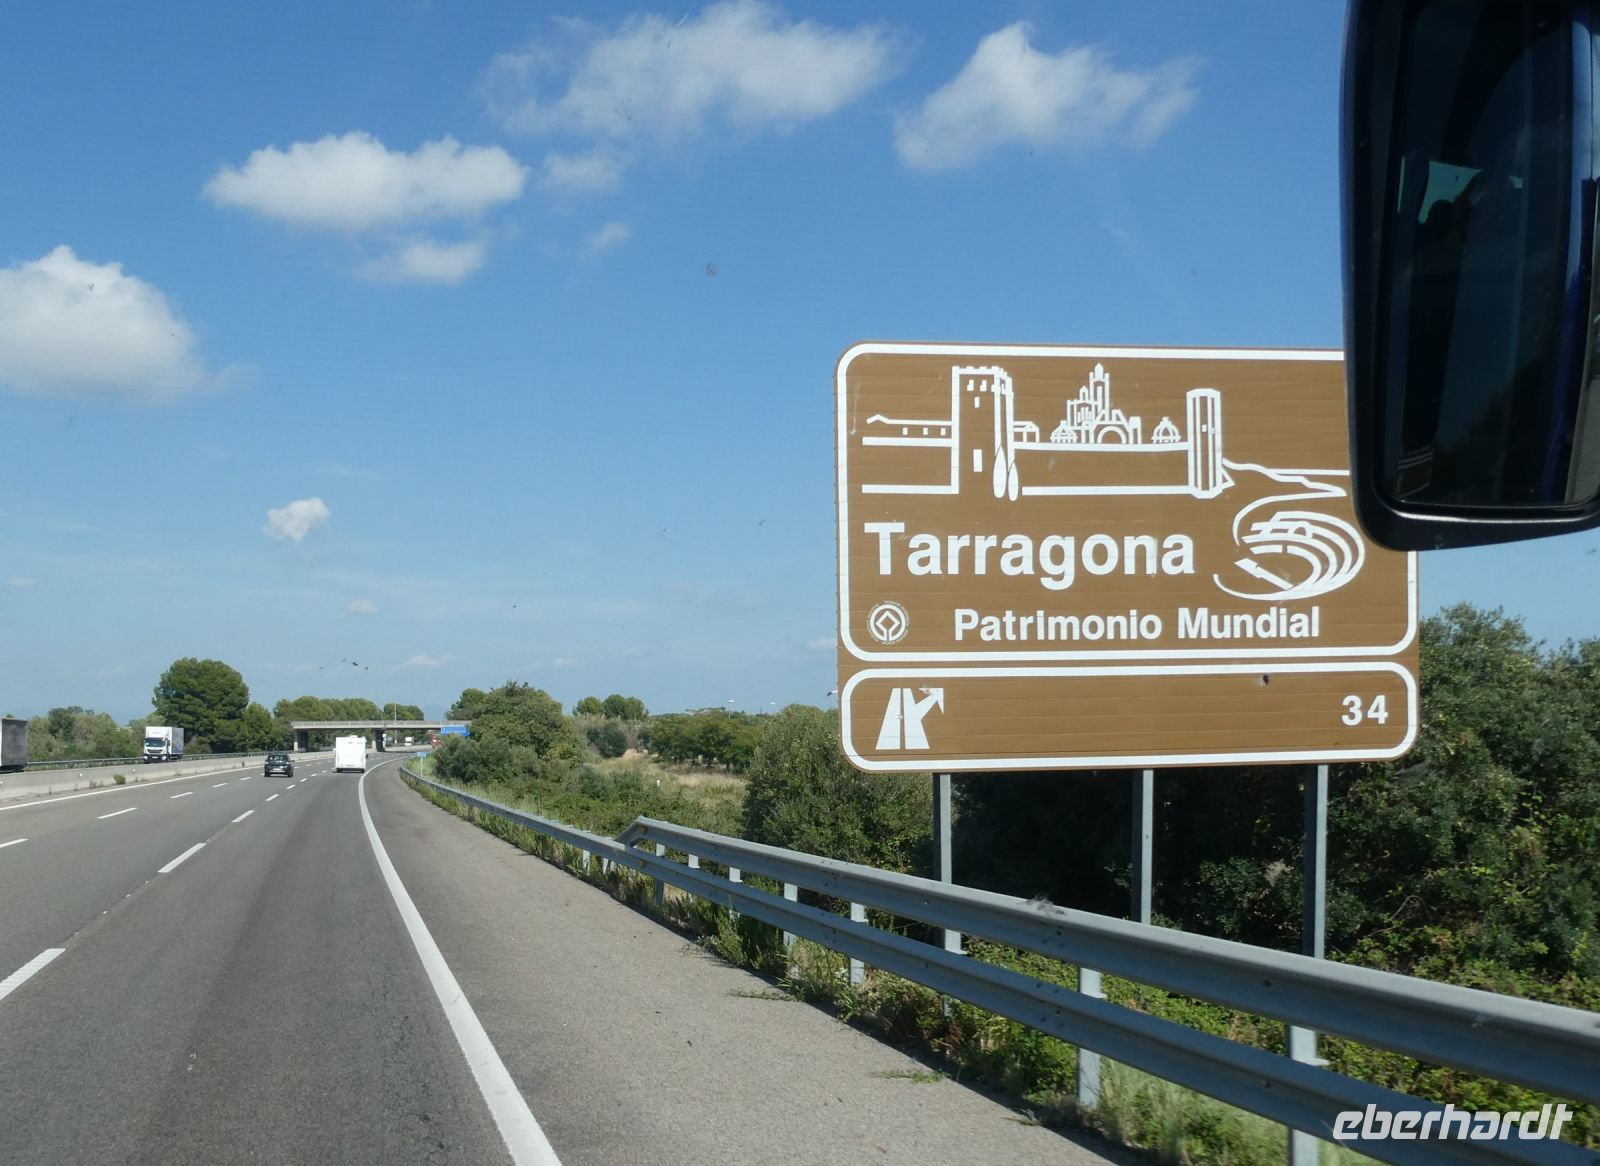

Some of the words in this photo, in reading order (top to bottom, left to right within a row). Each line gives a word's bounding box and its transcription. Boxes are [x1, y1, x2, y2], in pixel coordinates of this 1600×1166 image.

[863, 521, 1195, 590] Tarragona
[954, 608, 1162, 641] Patrimonio
[1177, 606, 1319, 638] Mundial
[1341, 694, 1389, 725] 34
